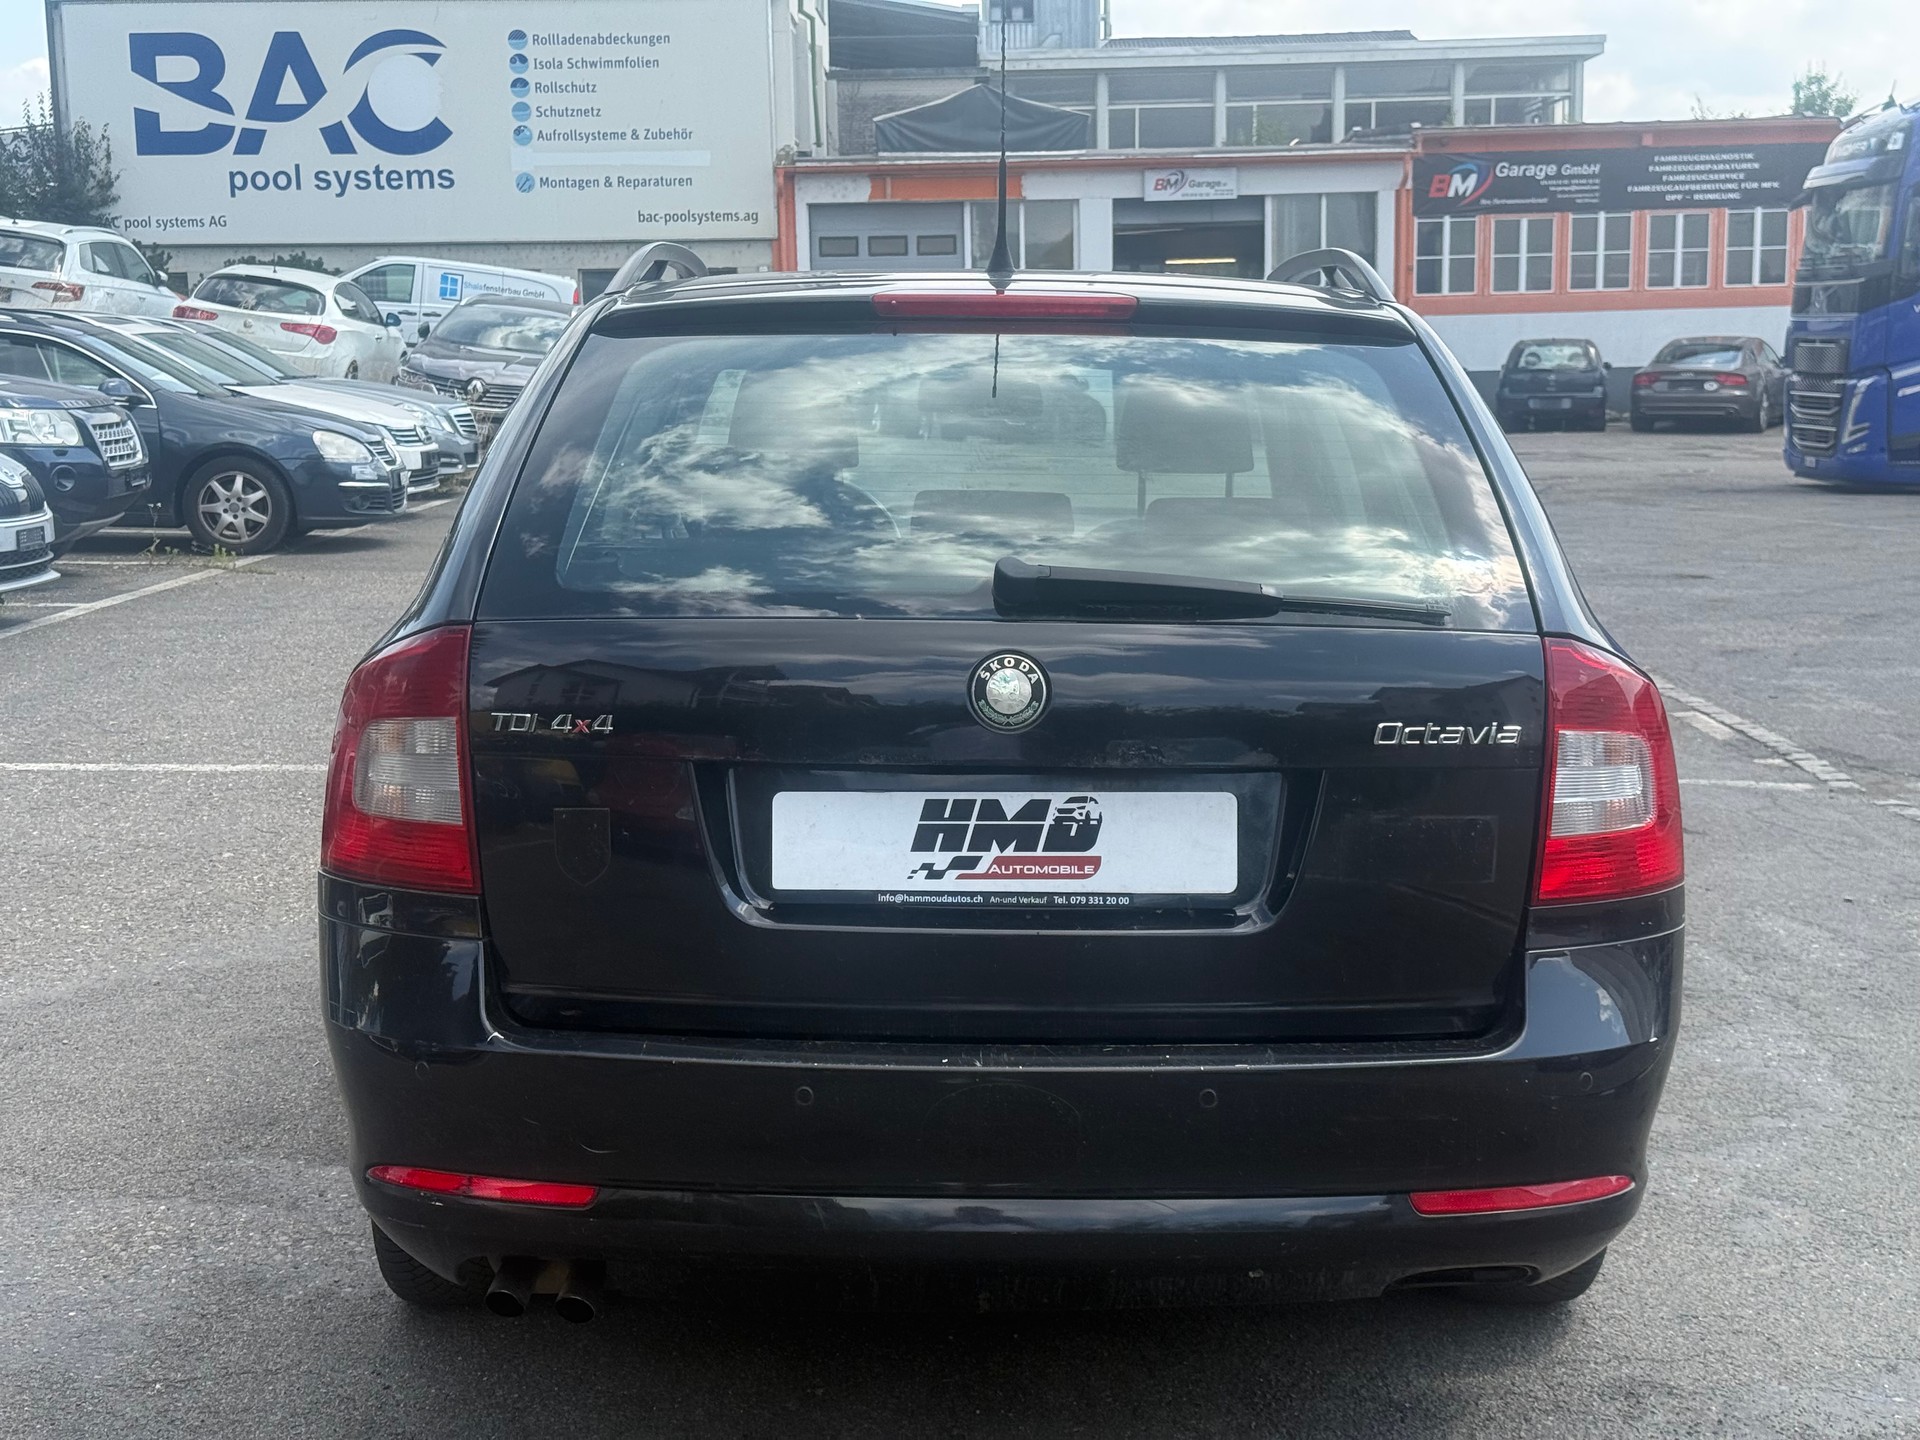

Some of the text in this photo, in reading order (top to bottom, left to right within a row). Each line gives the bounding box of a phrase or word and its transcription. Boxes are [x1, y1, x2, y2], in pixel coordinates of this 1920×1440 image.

[532, 33, 670, 47] Rollladenabdeckungen
[533, 57, 659, 70] Isola Schwimmfolien
[129, 29, 453, 156] BAC
[534, 81, 597, 94] Rollschutz
[535, 105, 602, 118] Schutznetz
[537, 127, 693, 144] Aufrollsysteme & Zubehör
[1495, 162, 1557, 179] Garage
[1561, 164, 1600, 176] GmbH
[229, 163, 455, 198] pool systems
[539, 175, 693, 191] Montagen & Reparaturen
[98, 214, 227, 231] AC pool systems AG
[638, 210, 759, 225] bac-poolsystems.ag
[980, 657, 1039, 684] SKODA
[491, 712, 613, 734] TDI 4x4
[1374, 721, 1522, 745] Octavia
[988, 864, 1095, 875] AUTOMOBILE
[989, 895, 1017, 904] An-und
[1019, 895, 1048, 904] Verkauf
[1053, 895, 1069, 905] Tel.
[1070, 896, 1086, 905] 079
[1088, 896, 1104, 905] 331
[1106, 896, 1117, 905] 20
[1118, 896, 1130, 905] 00
